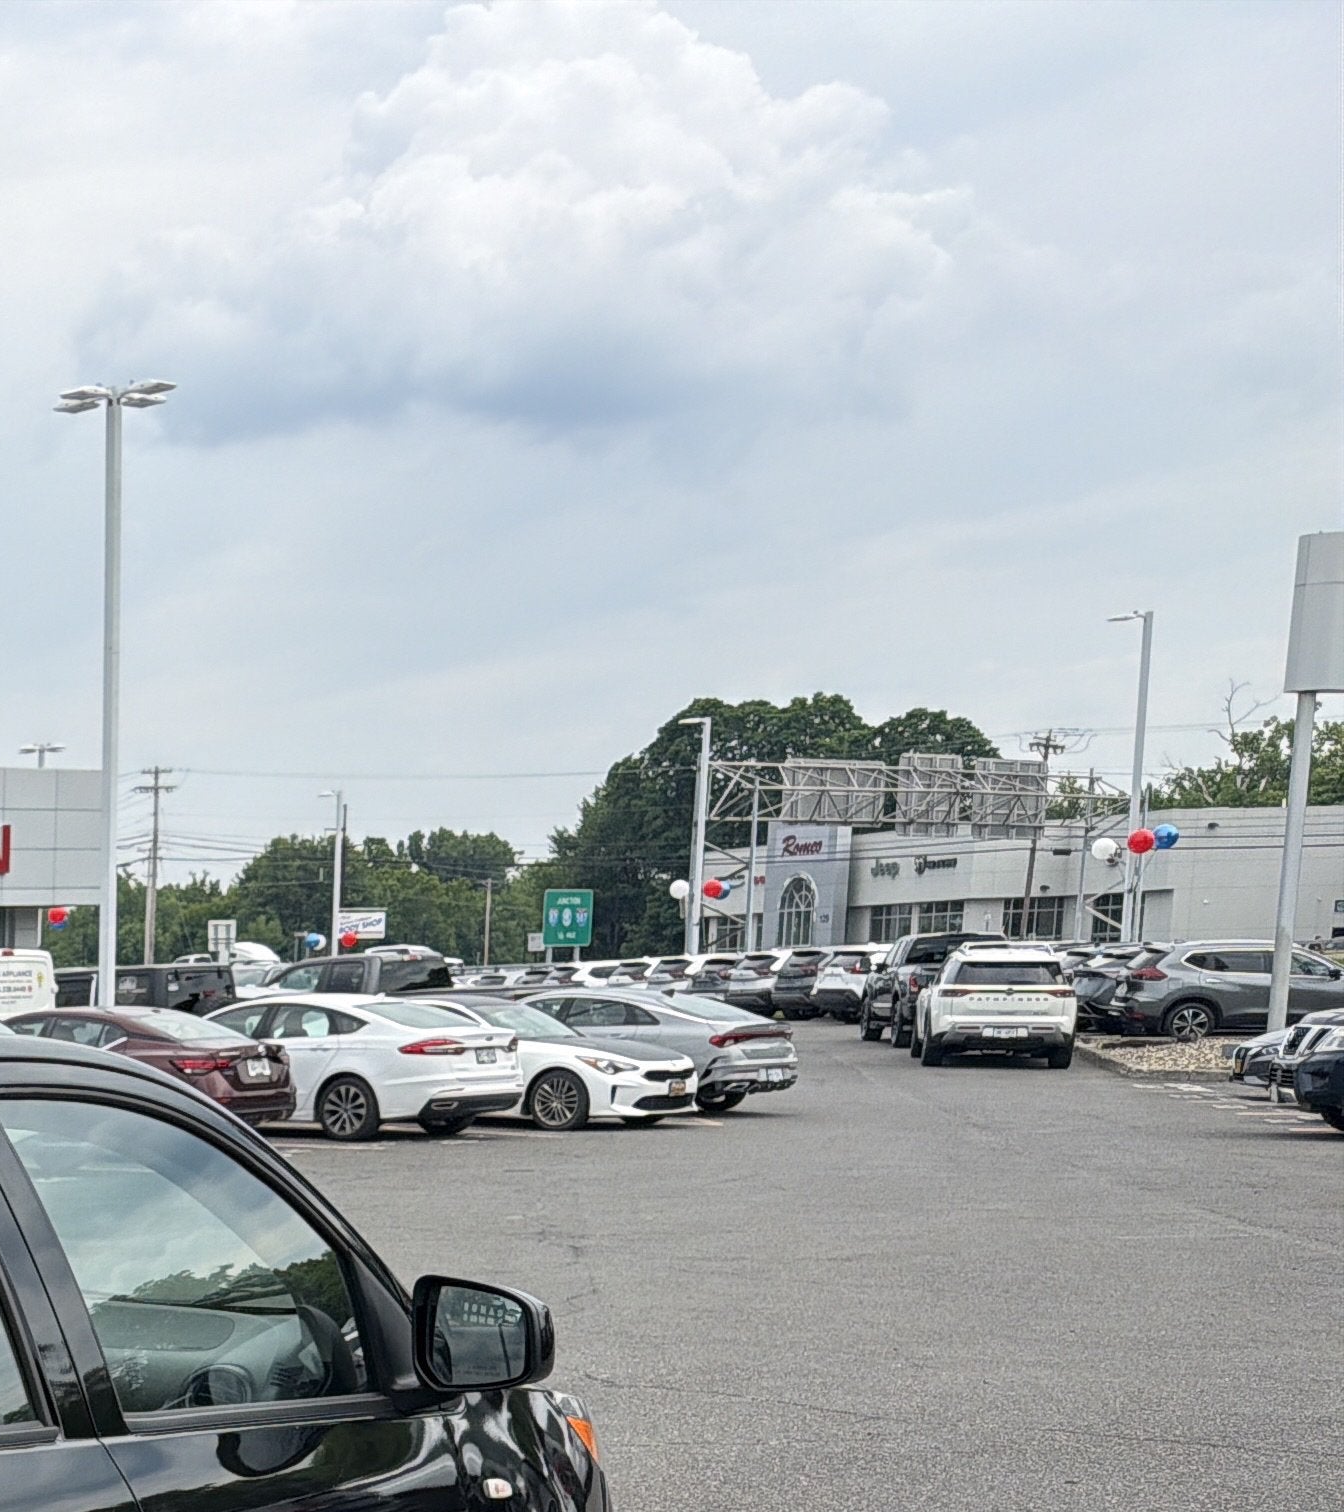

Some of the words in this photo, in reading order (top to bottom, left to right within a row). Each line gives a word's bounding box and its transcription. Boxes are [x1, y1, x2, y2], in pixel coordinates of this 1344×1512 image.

[782, 834, 823, 857] Romeo
[871, 858, 900, 880] Jeep
[2, 969, 33, 978] APPLIANCE
